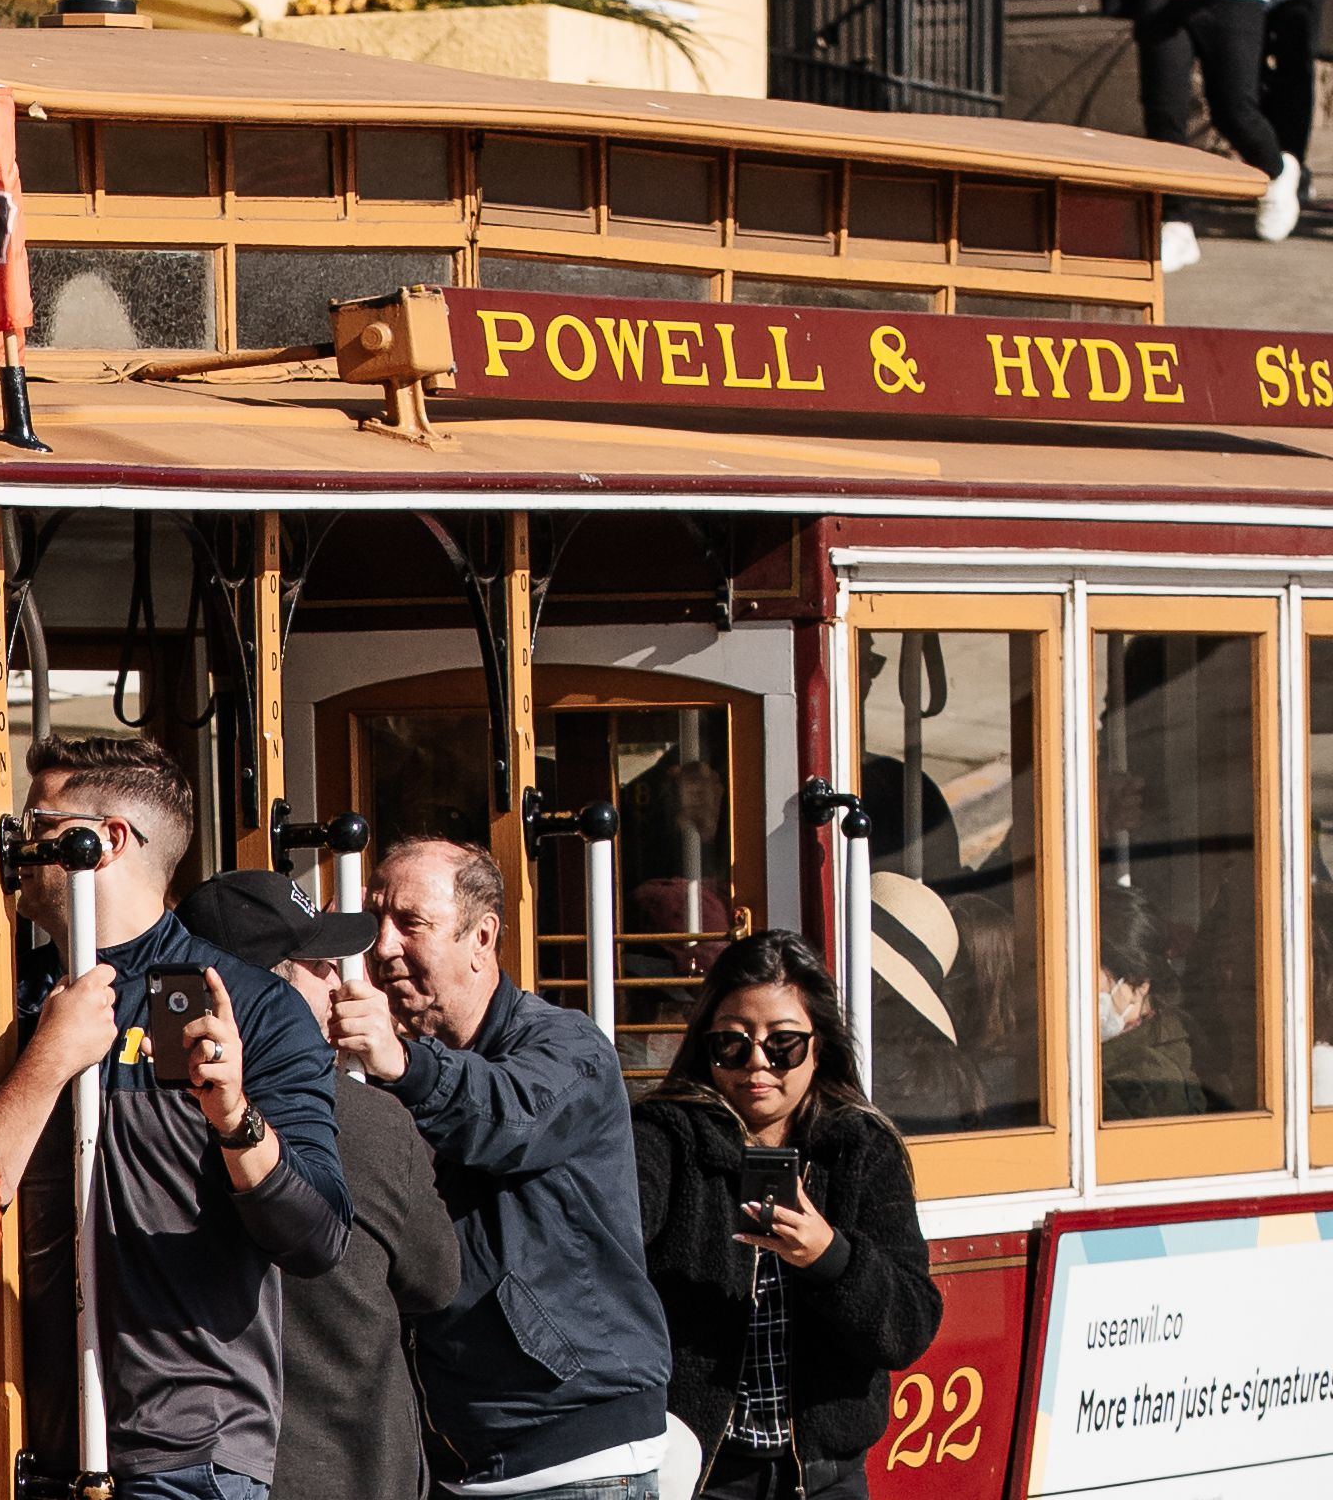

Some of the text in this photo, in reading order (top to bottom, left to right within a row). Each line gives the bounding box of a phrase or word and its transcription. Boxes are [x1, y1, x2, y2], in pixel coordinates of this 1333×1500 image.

[477, 309, 1333, 408] POWELL & HYDE Sts
[1086, 1304, 1183, 1350] useanvil.co
[887, 1366, 984, 1472] 22
[1076, 1389, 1127, 1433] More
[1132, 1384, 1174, 1426] than
[1175, 1377, 1217, 1433] just
